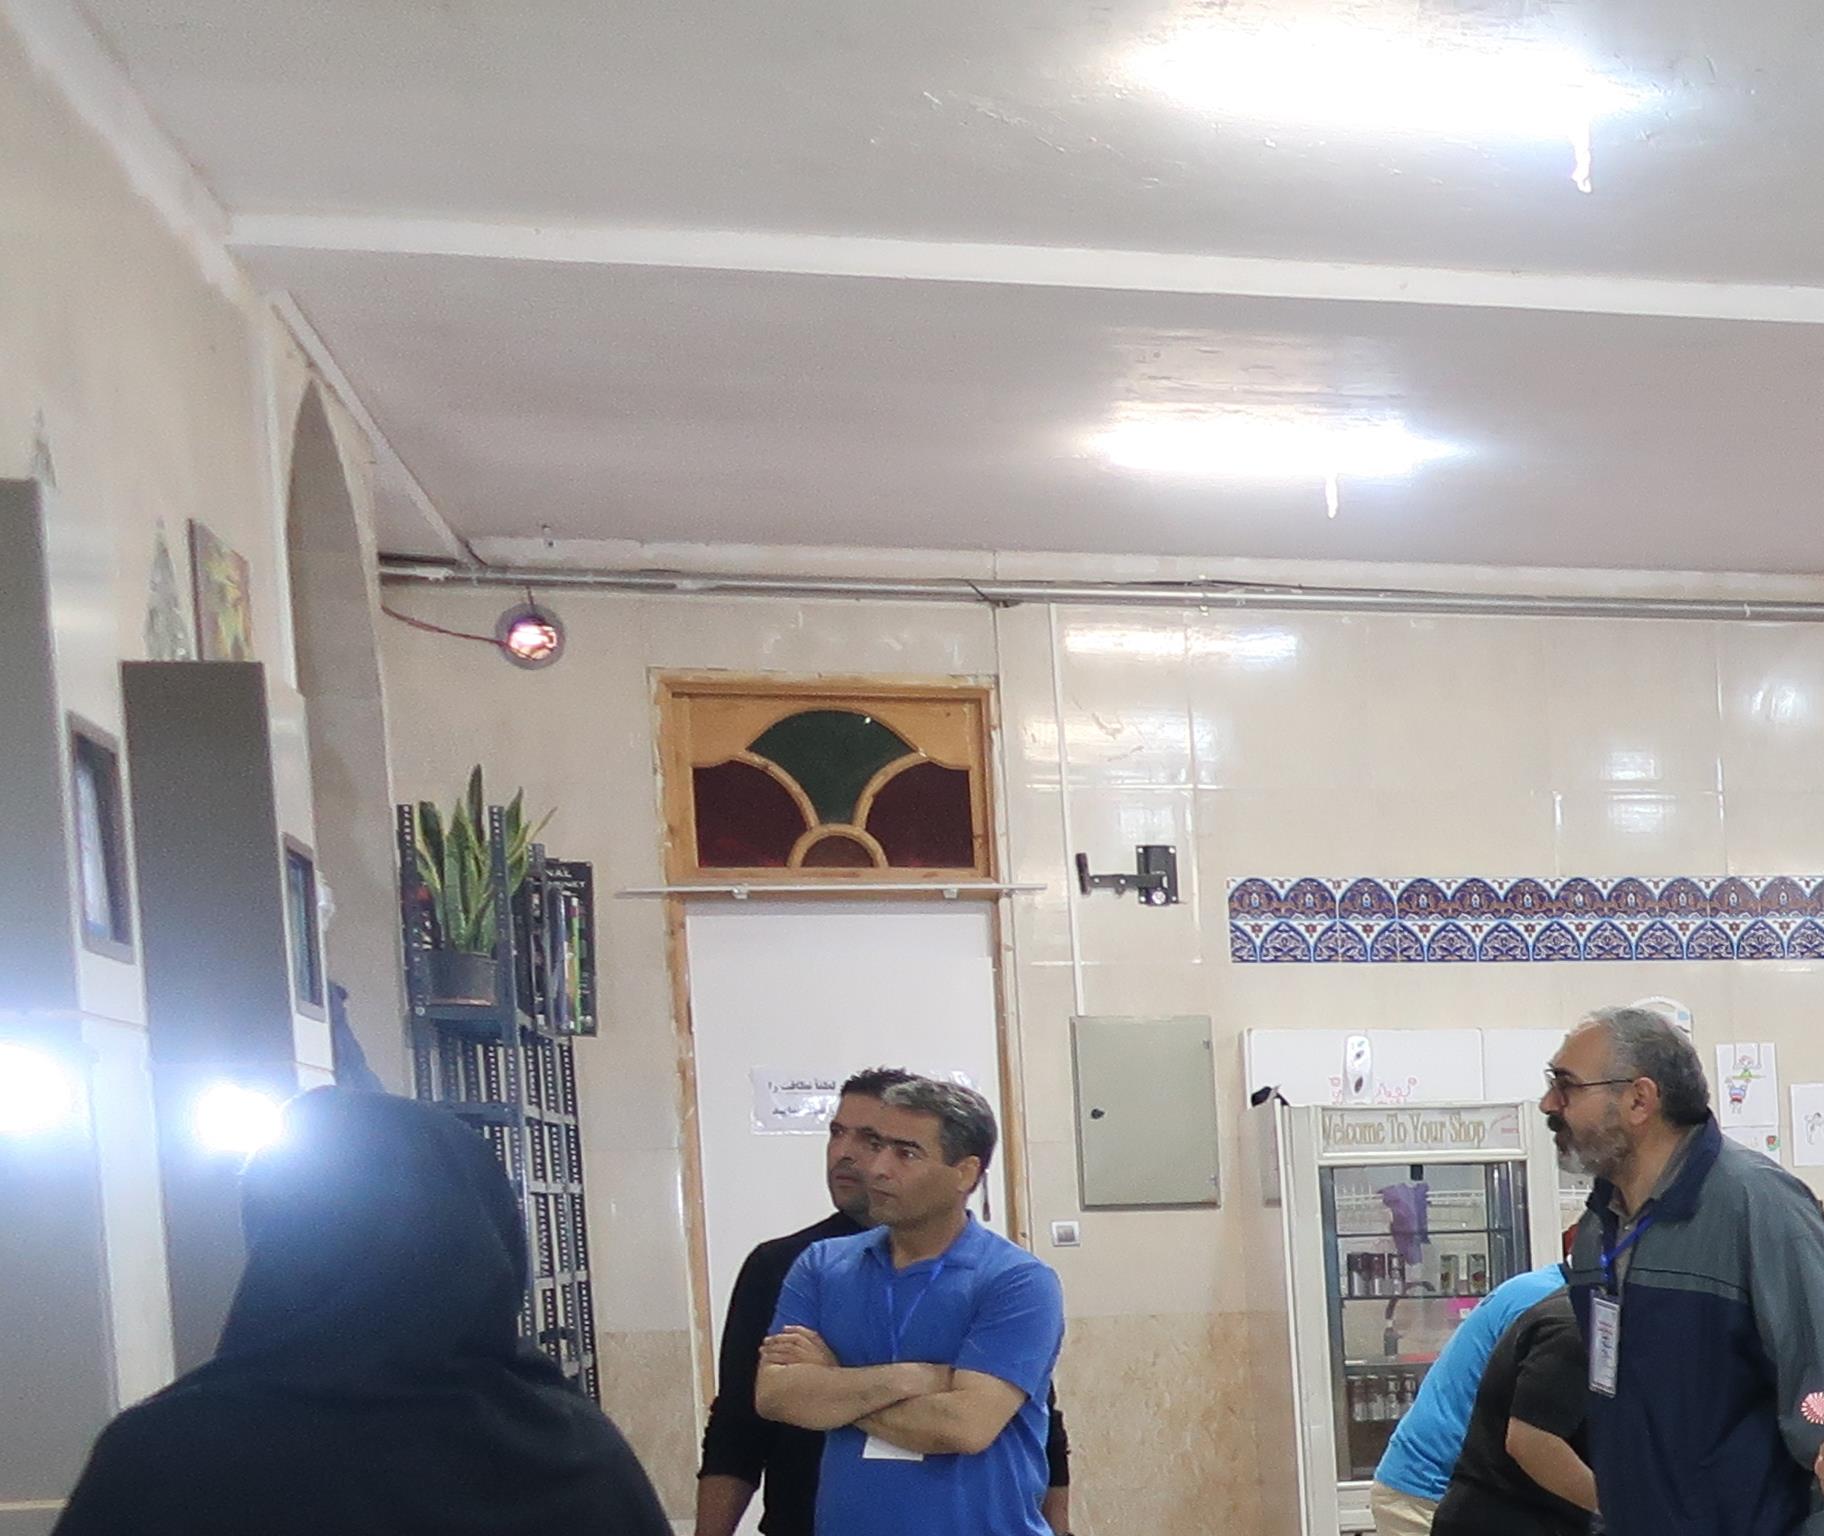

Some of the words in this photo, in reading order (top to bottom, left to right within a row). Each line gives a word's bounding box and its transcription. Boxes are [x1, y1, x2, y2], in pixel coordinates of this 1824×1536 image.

[1387, 1113, 1408, 1145] To
[1408, 1112, 1448, 1145] Your
[1449, 1112, 1486, 1149] Shop
